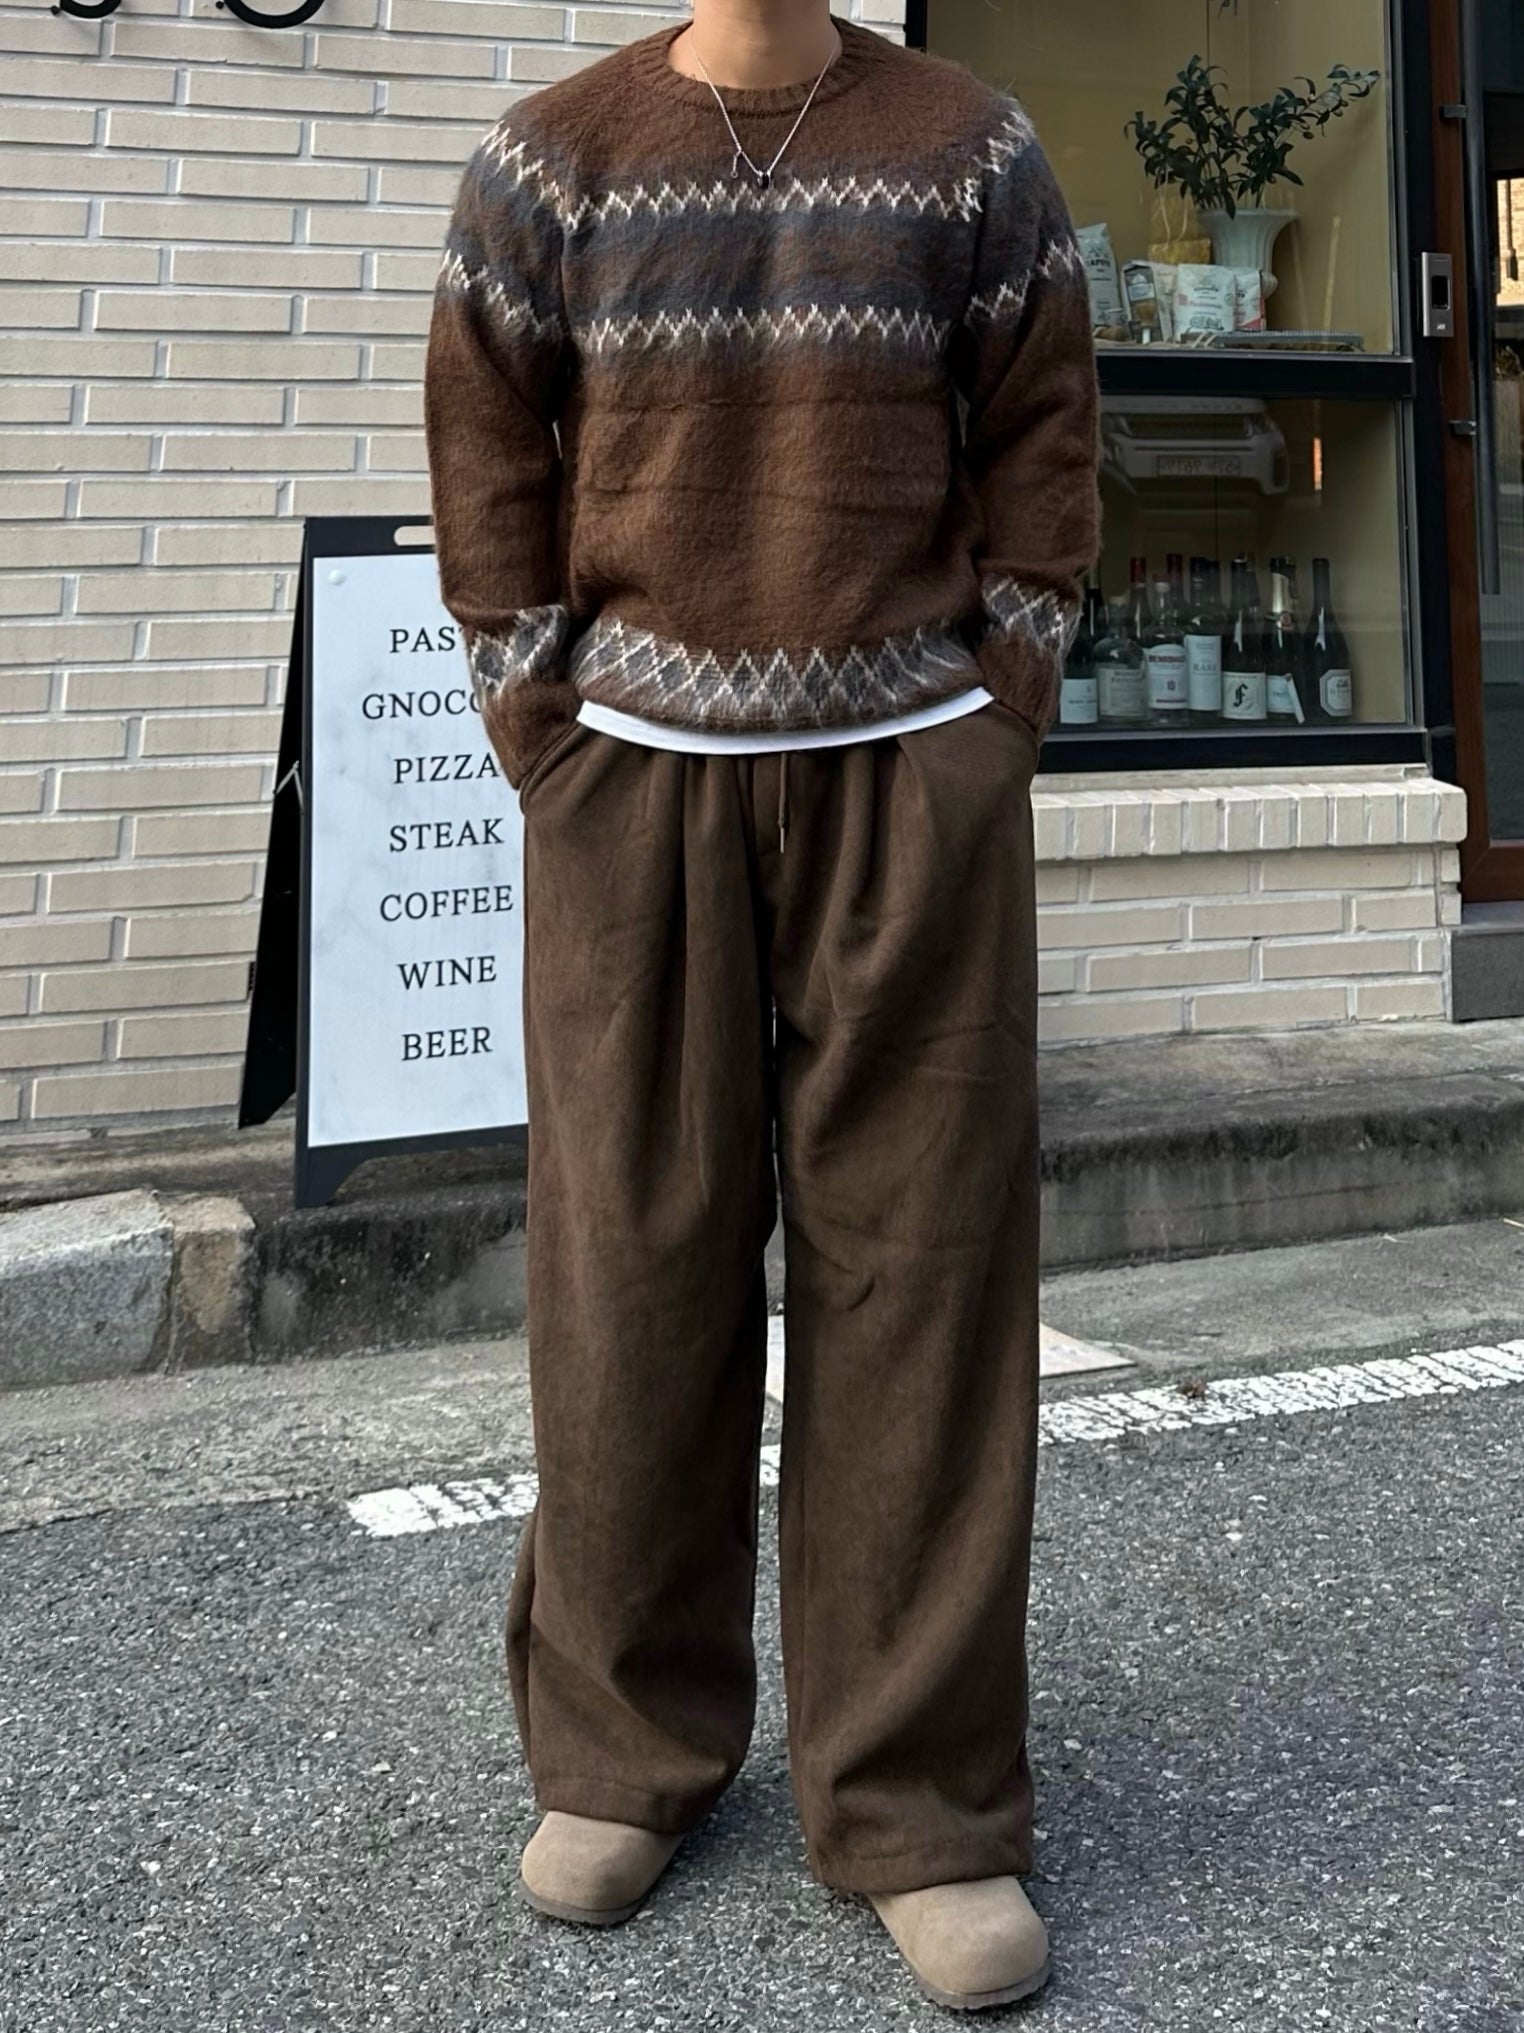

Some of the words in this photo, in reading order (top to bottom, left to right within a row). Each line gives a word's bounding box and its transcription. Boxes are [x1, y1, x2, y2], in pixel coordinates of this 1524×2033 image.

[390, 626, 463, 653] PAS
[394, 752, 500, 784] PIZZA
[389, 818, 504, 853] STEAK
[380, 885, 514, 922] COFFEE
[397, 955, 497, 990] WINE
[402, 1026, 492, 1061] BEER
